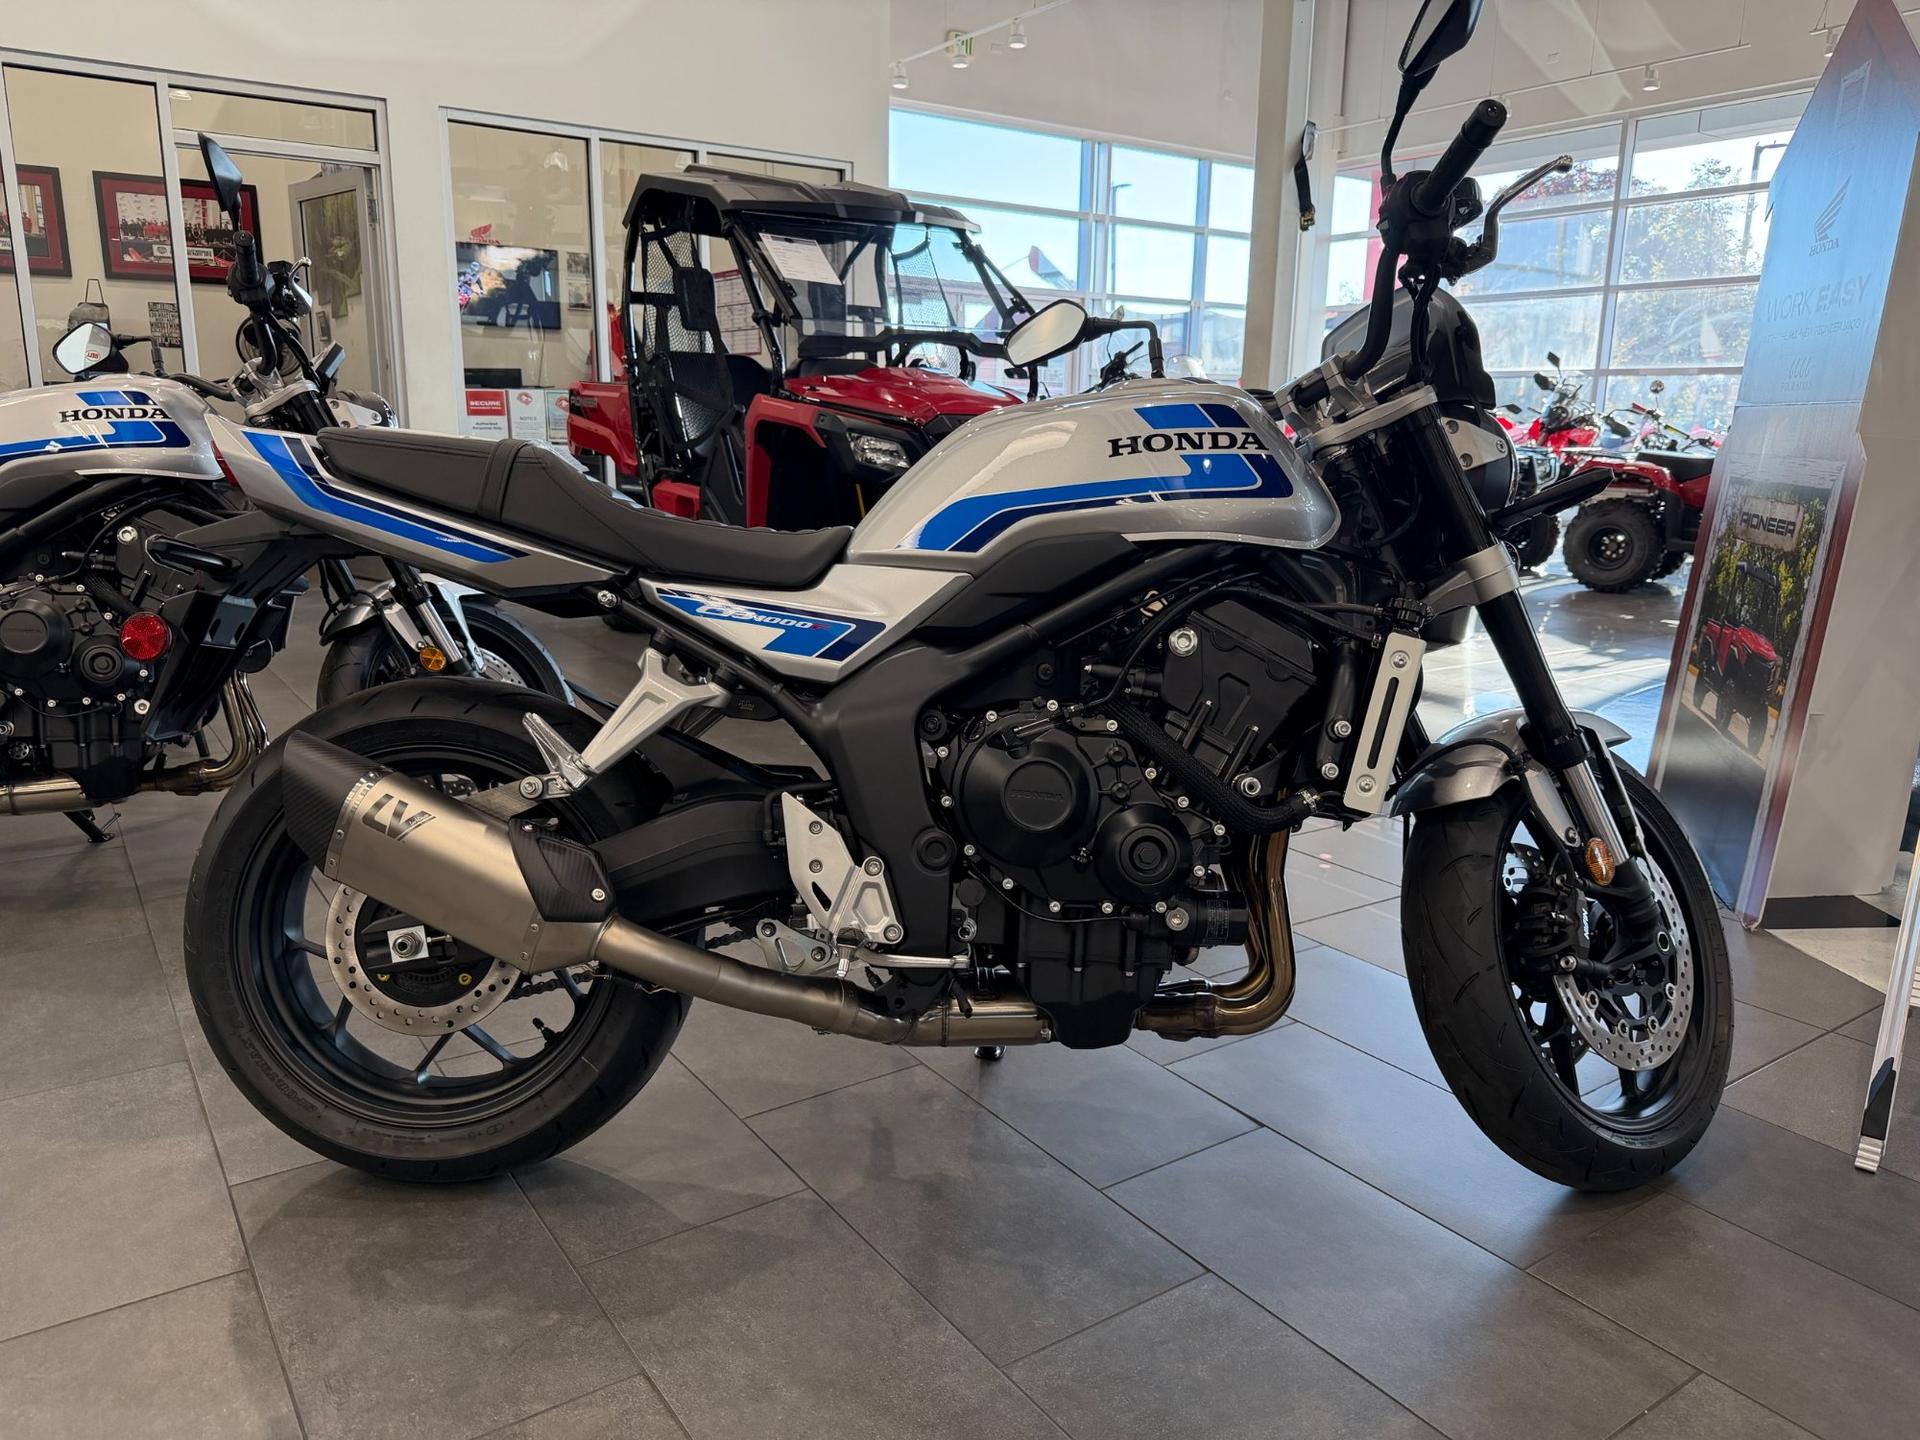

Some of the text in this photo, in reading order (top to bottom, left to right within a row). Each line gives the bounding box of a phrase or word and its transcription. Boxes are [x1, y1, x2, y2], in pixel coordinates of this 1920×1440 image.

[1808, 238, 1840, 256] HONDA
[1767, 272, 1872, 323] WORK EASY
[58, 407, 173, 423] HONDA
[1107, 432, 1270, 458] HONDA
[1740, 511, 1797, 538] PIONEER
